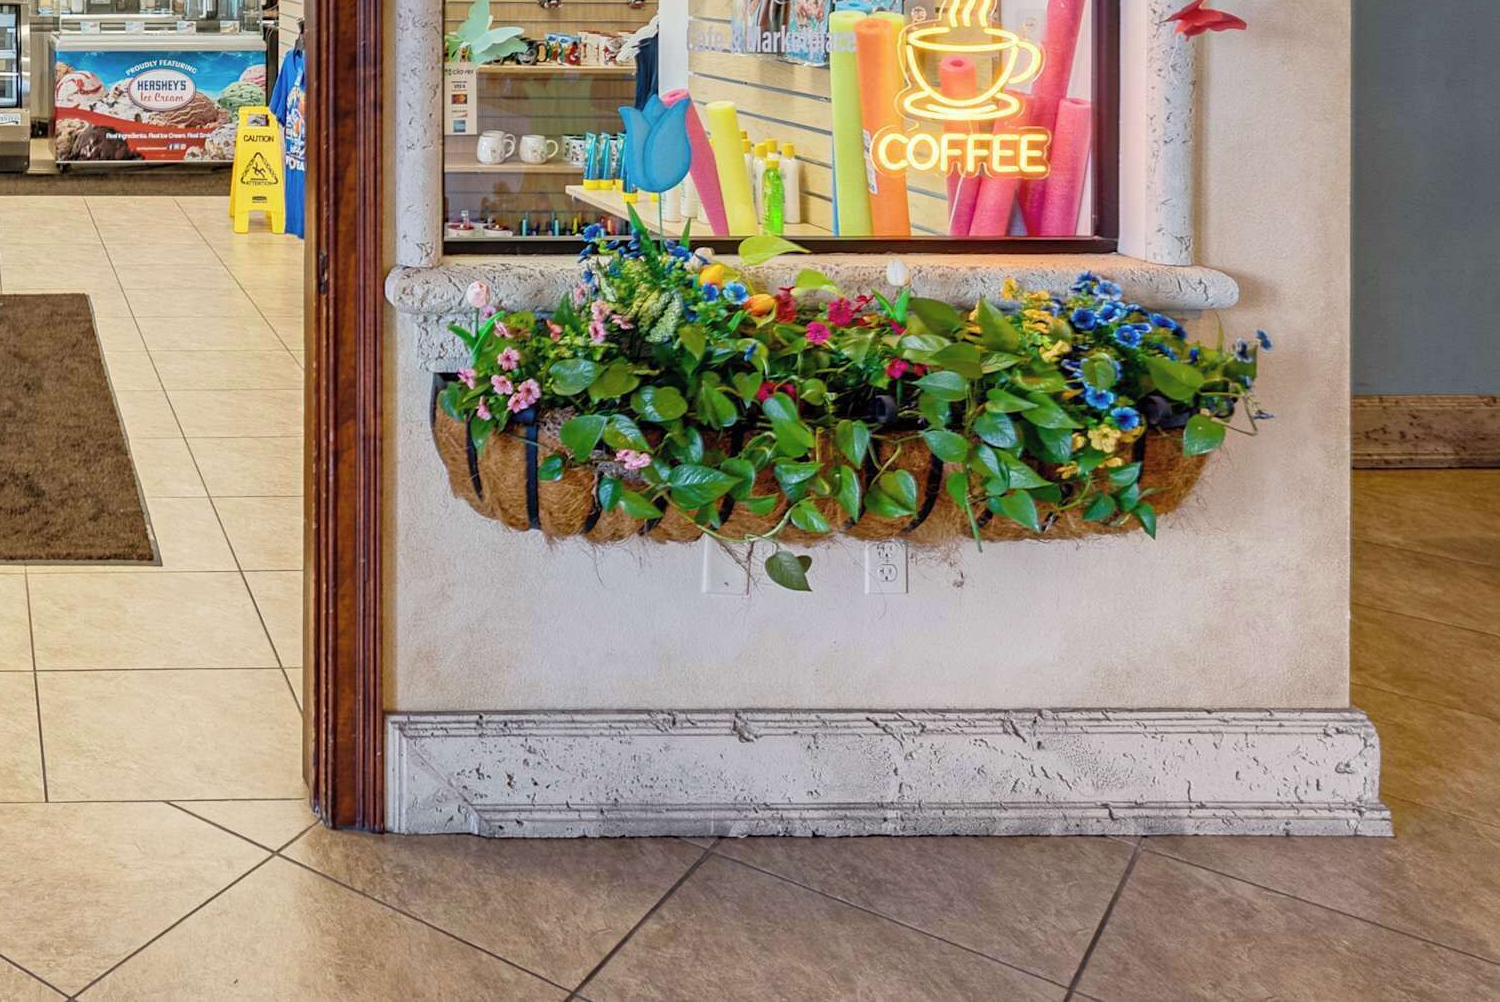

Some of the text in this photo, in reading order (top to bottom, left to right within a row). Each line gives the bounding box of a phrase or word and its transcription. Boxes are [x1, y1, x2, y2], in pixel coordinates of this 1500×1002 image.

[125, 59, 197, 75] PROUDLY FEATURING
[137, 80, 187, 91] HERSHEY'S
[141, 93, 184, 103] Ice Cream
[244, 134, 275, 143] CAUTION
[877, 132, 1048, 172] COFFEE
